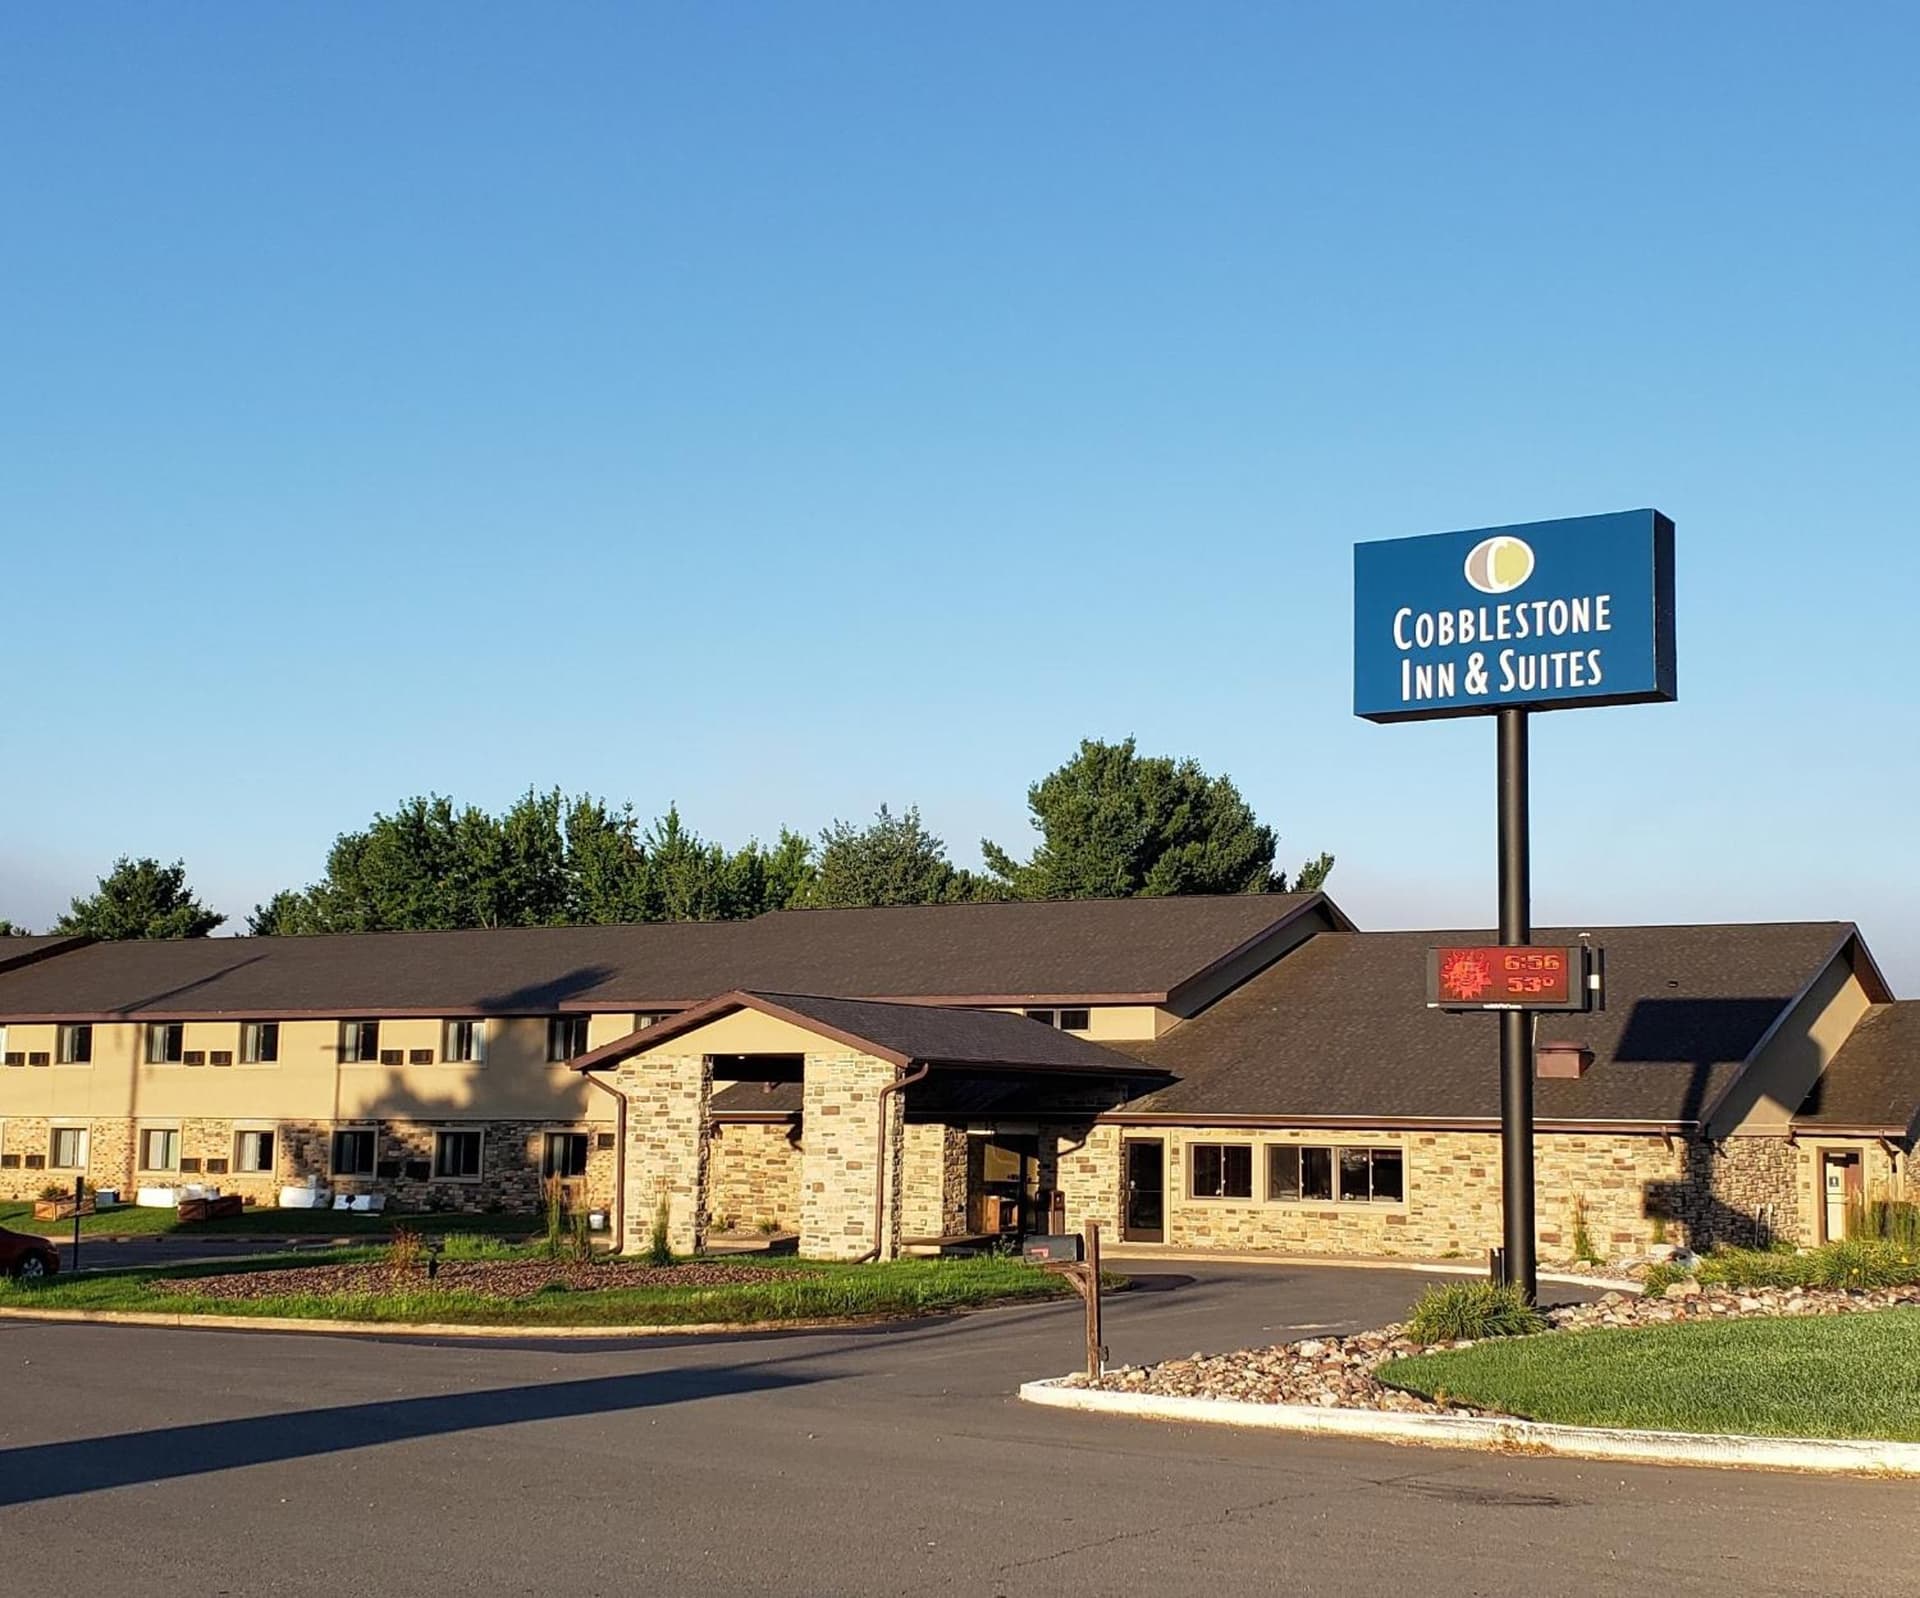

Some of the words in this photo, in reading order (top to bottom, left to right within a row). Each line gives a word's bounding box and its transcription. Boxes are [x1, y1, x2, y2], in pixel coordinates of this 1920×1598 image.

[1393, 594, 1611, 650] COBBLESTONE
[1402, 658, 1455, 702] INN
[1464, 652, 1488, 696] &
[1499, 649, 1602, 693] SUITES
